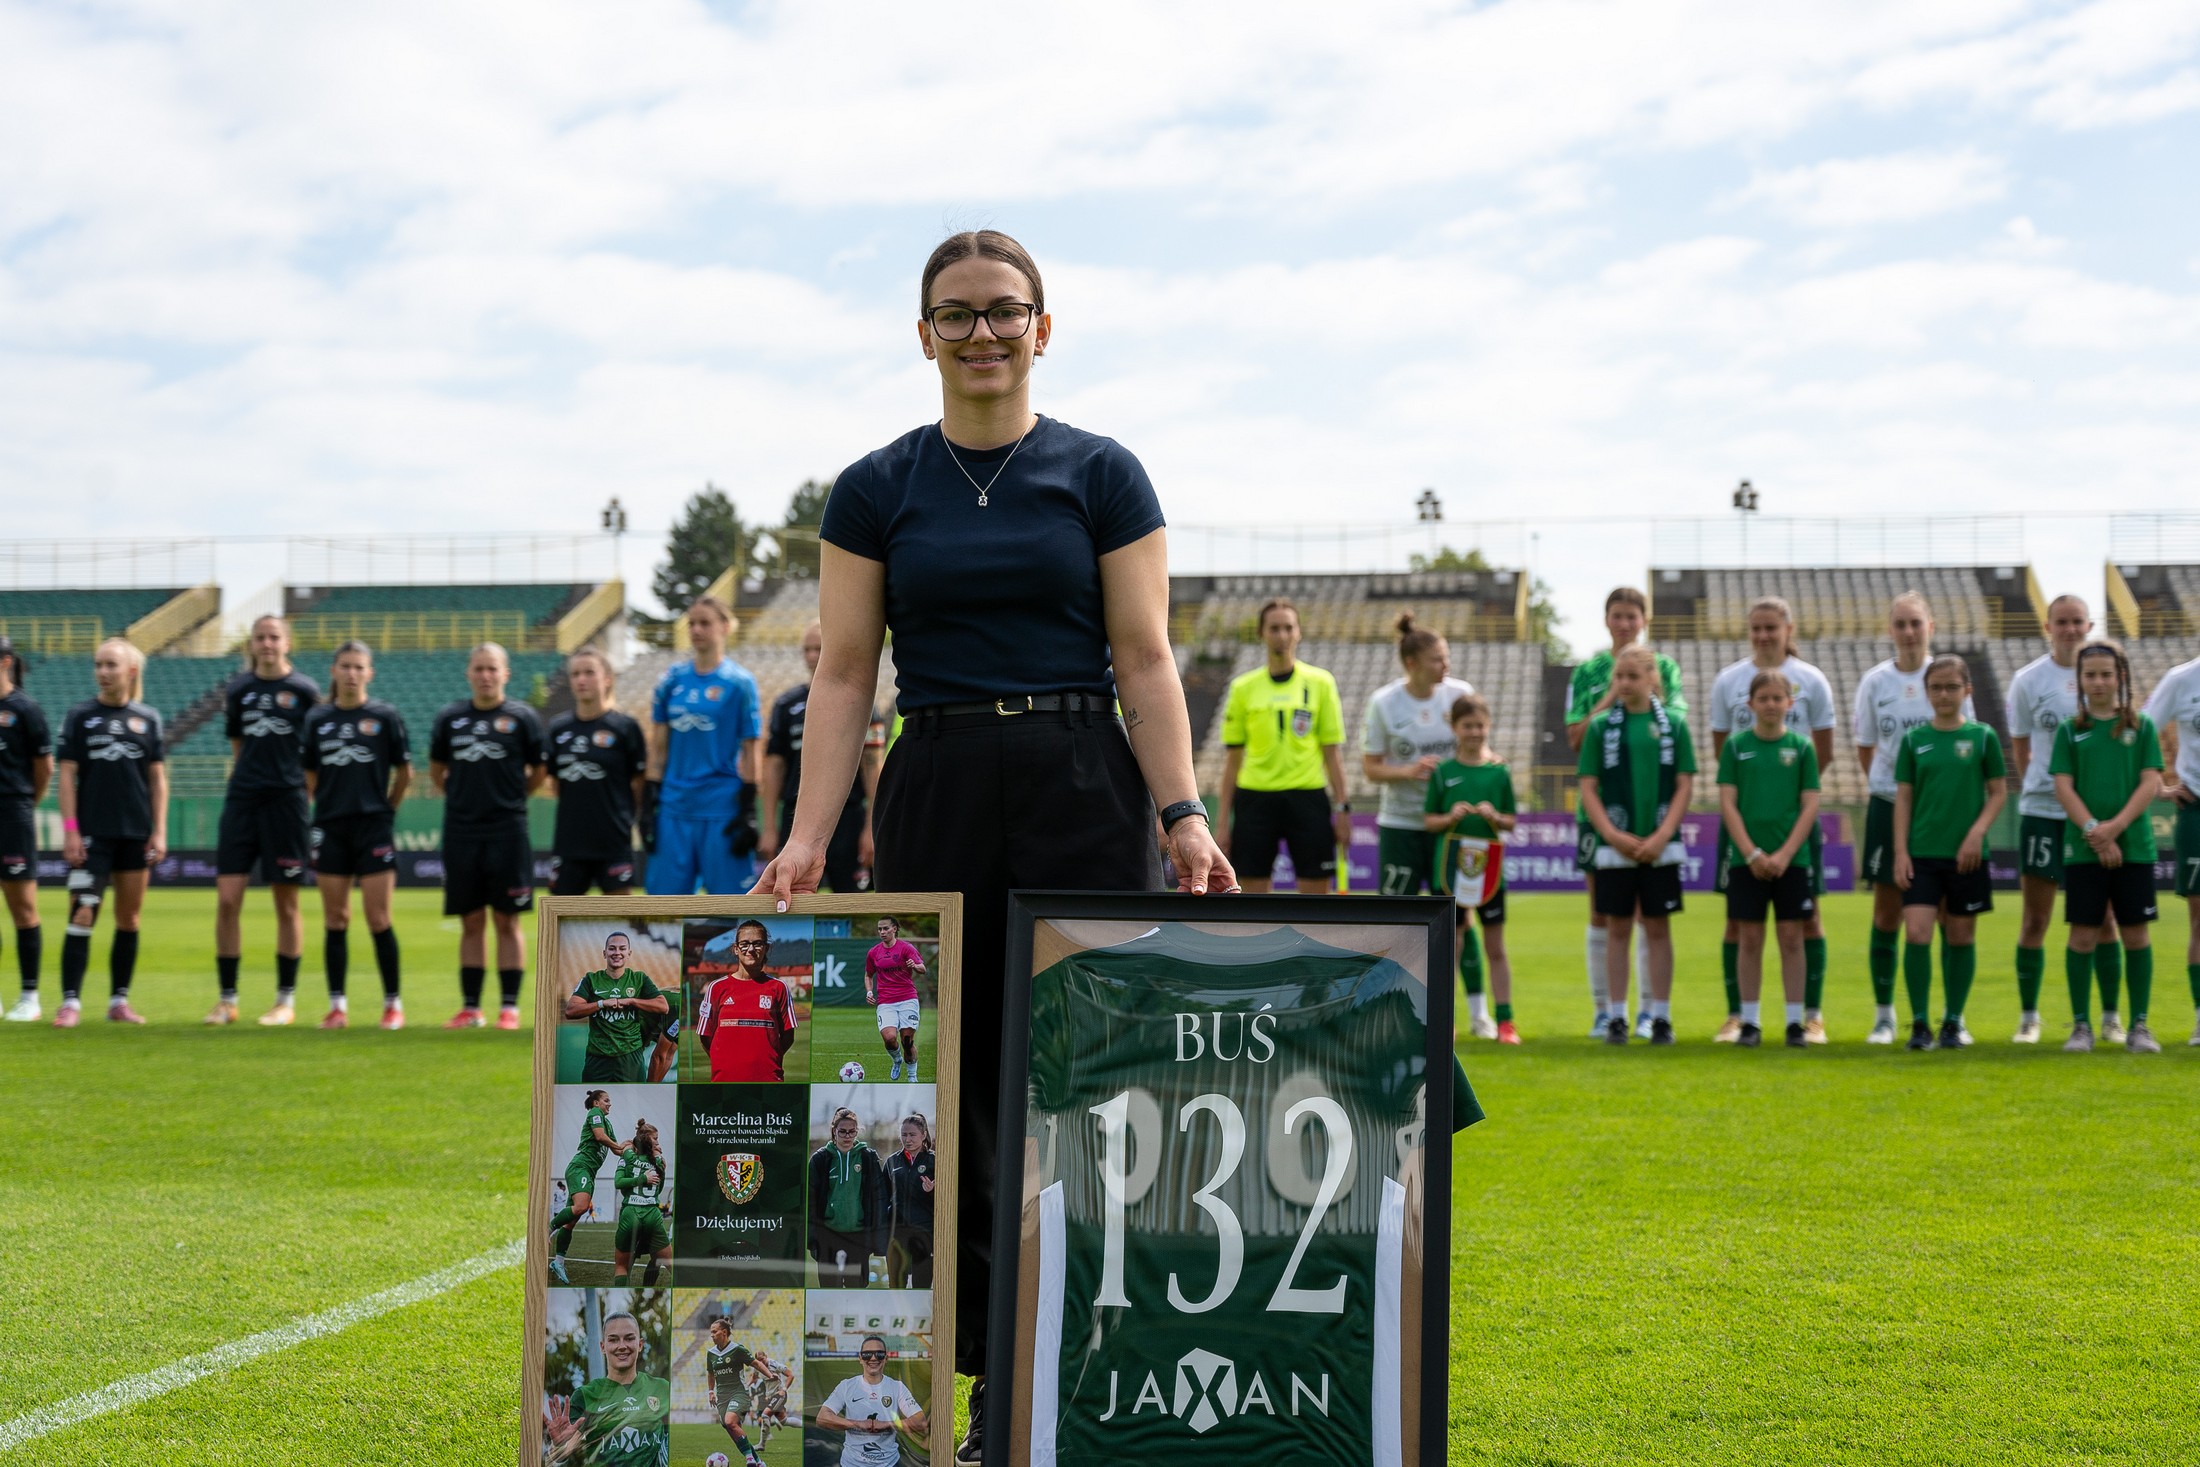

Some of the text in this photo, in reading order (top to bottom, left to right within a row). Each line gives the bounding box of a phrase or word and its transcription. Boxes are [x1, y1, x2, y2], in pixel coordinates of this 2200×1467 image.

[2027, 835, 2052, 867] 15
[1382, 864, 1413, 895] 27
[1174, 1003, 1278, 1063] BUŚ
[692, 1112, 792, 1126] Marcelina Buś
[581, 1177, 587, 1189] 9
[1087, 1090, 1354, 1314] 132
[695, 1215, 783, 1233] Dziękujemy!
[1099, 1346, 1330, 1434] JAXAN
